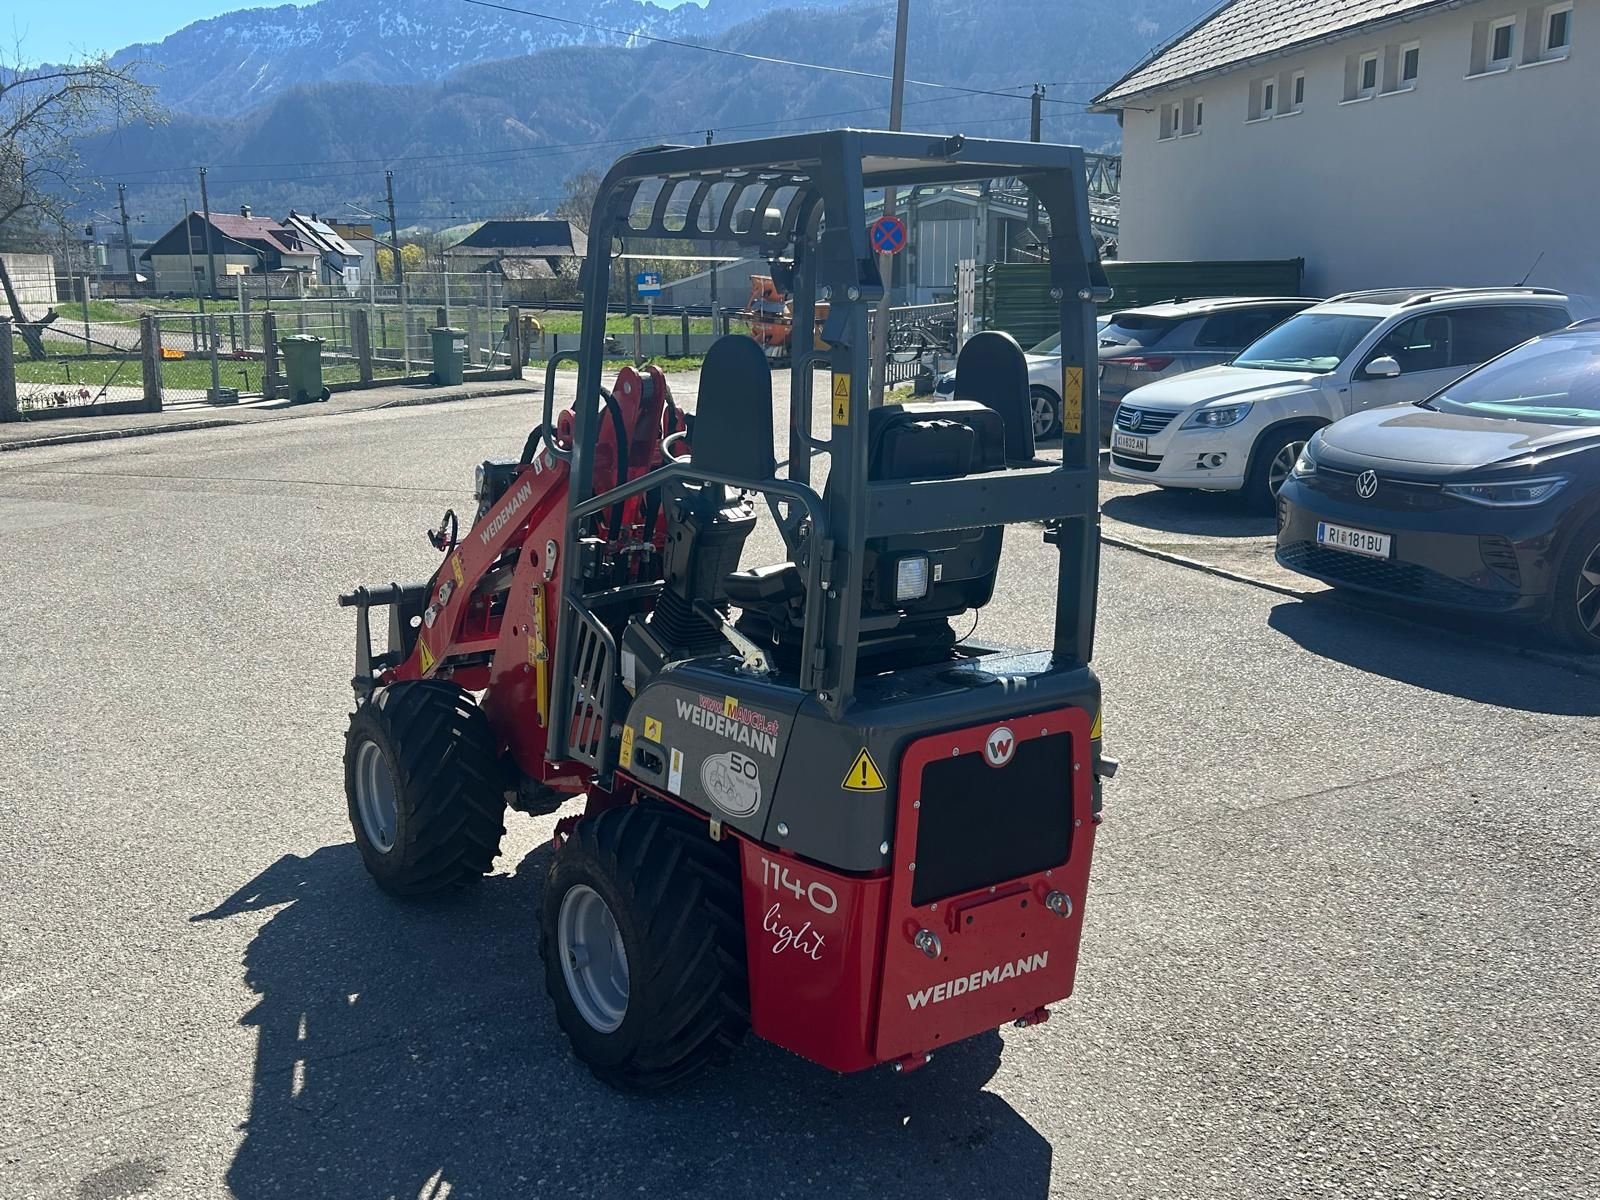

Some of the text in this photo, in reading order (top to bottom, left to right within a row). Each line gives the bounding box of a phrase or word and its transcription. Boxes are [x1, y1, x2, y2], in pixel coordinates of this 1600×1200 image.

[480, 481, 532, 545] WEIDEMANN
[1329, 527, 1339, 544] RI
[676, 698, 777, 758] WEIDEMANN
[730, 753, 757, 780] 50
[761, 857, 838, 914] 1140
[763, 902, 826, 960] light
[906, 950, 1049, 1010] WEIDEMANN
